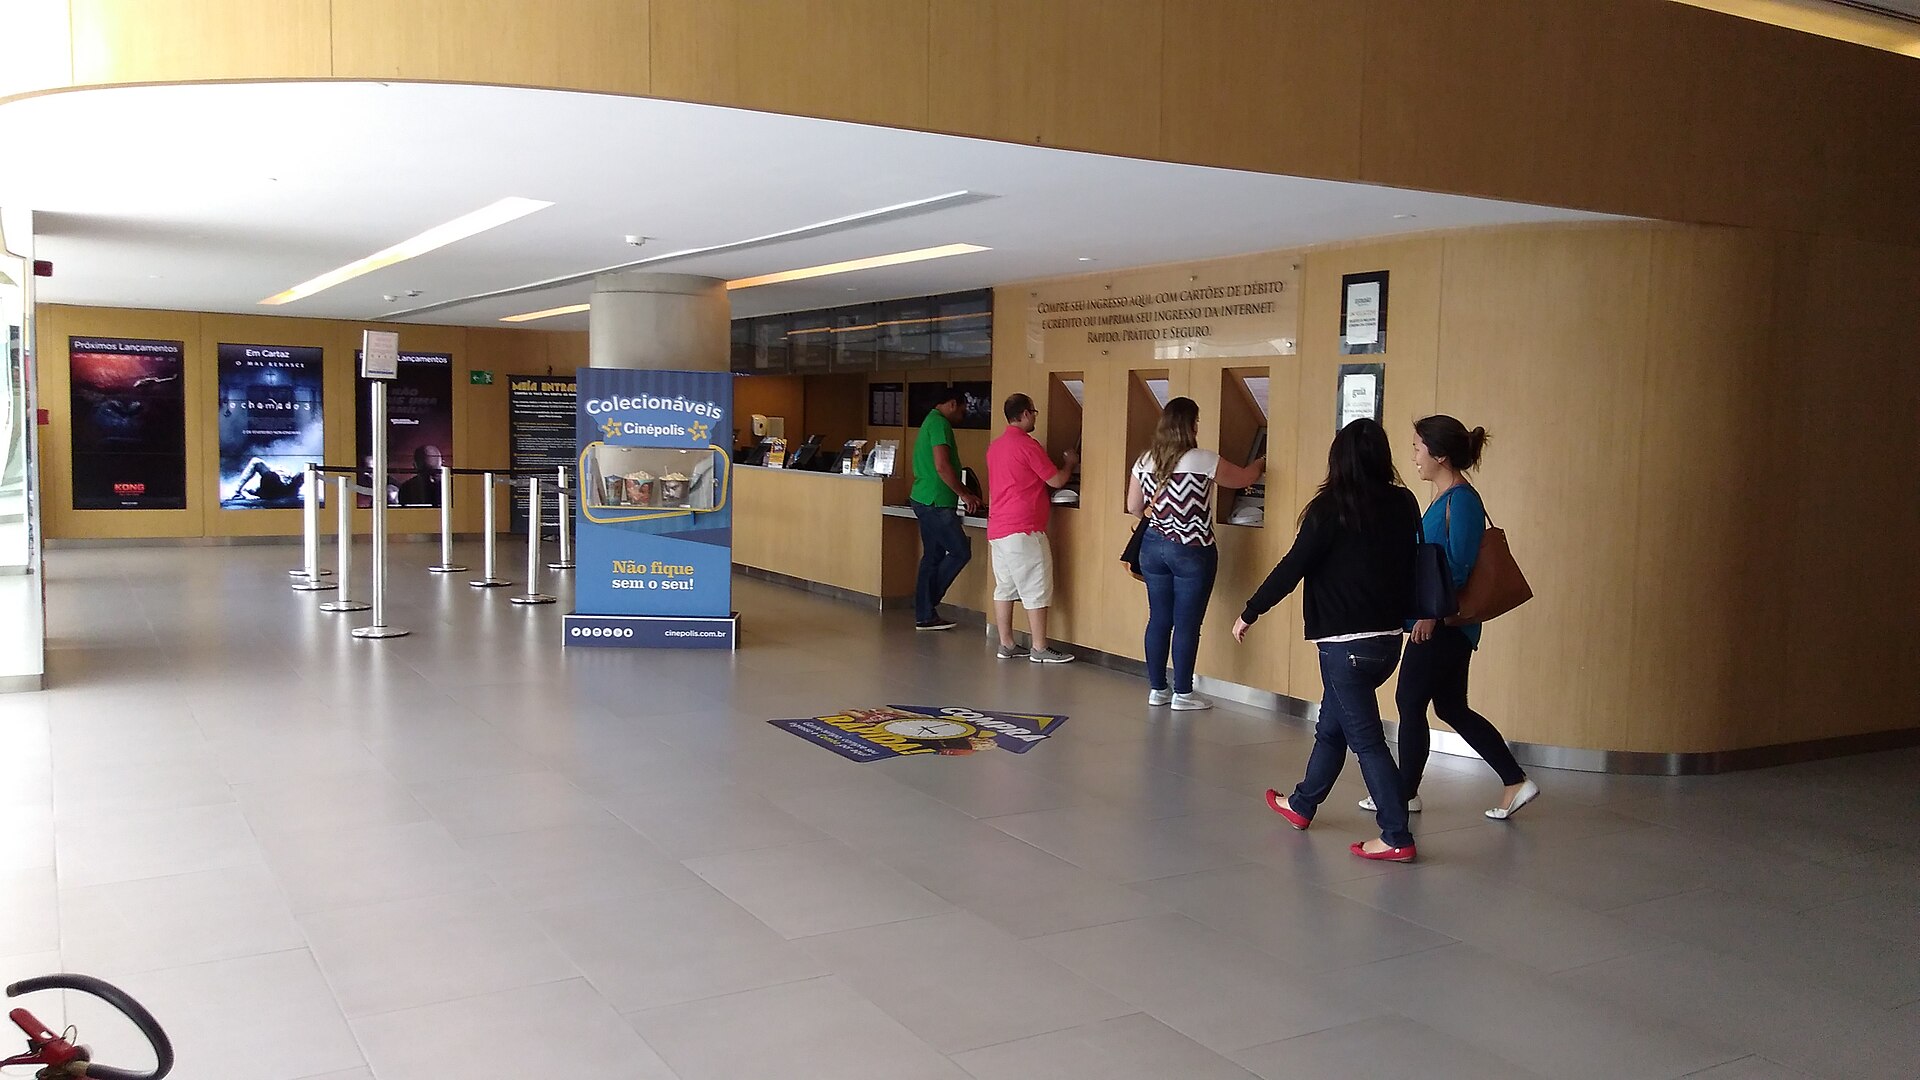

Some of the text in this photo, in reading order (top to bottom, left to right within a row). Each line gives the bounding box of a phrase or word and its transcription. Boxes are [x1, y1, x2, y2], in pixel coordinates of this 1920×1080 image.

[1087, 296, 1127, 310] INGRESSO
[1155, 292, 1178, 304] COM
[1180, 285, 1224, 302] CARTÕES
[1227, 284, 1241, 298] DE
[1244, 280, 1284, 296] DÉBITO
[1083, 316, 1097, 327] OU
[1098, 313, 1134, 326] IMPRIMA
[1136, 311, 1153, 323] SEU
[1154, 307, 1201, 321] INGRESSO
[1204, 306, 1219, 318] DA
[1162, 328, 1168, 339] E
[74, 340, 178, 353] Próximos Lançamentos
[245, 349, 290, 358] Em Cartaz
[397, 354, 448, 364] Lançamentos
[541, 382, 577, 392] ENTRA
[240, 399, 300, 411] chamado
[303, 403, 311, 411] 3
[586, 394, 722, 419] Colecionáveis
[623, 422, 685, 437] Cinépolis
[114, 483, 145, 491] KONG
[612, 560, 694, 578] Não fique
[611, 578, 694, 590] sem o seu!
[664, 629, 727, 638] cinepolis.com.br
[940, 706, 1048, 742] COMPRA
